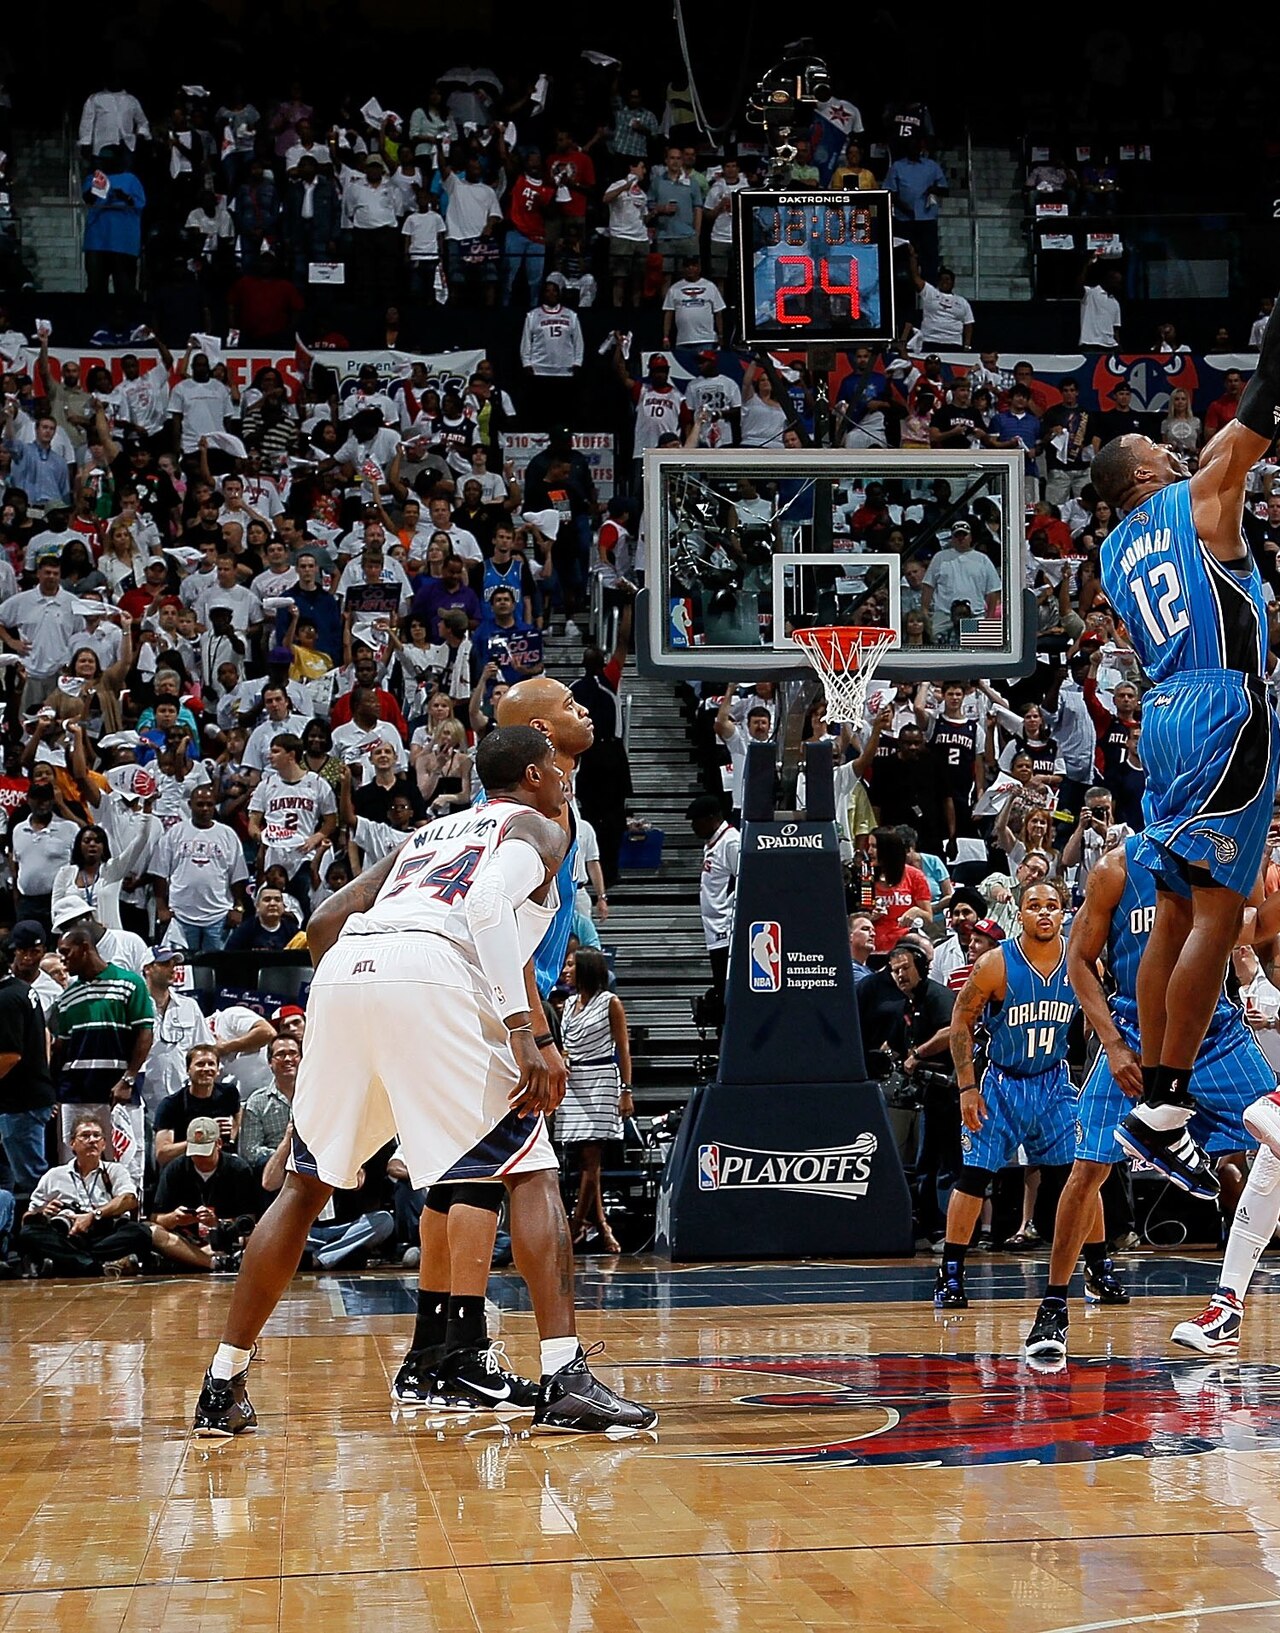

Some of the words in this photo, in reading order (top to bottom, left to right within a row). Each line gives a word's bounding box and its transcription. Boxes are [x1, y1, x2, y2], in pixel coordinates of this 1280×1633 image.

[900, 125, 912, 137] 15
[511, 189, 527, 200] AT
[774, 254, 861, 325] 24
[550, 327, 562, 337] 15
[650, 404, 665, 417] 10
[1120, 527, 1171, 578] HOWARD
[361, 590, 385, 600] GO
[348, 599, 398, 610] HAWKS
[1130, 560, 1189, 647] 12
[508, 640, 529, 652] GO
[934, 734, 973, 751] ATLANTA
[949, 748, 961, 766] 2
[271, 797, 315, 811] HAWKS
[285, 813, 299, 831] 2
[757, 833, 824, 851] SPALDING
[786, 952, 824, 963] Where
[351, 959, 376, 975] ATL
[786, 965, 838, 979] amazing
[753, 977, 773, 989] NBA
[786, 977, 839, 991] happens.
[1026, 1027, 1055, 1058] 14
[720, 1155, 872, 1184] PLAYOFFS
